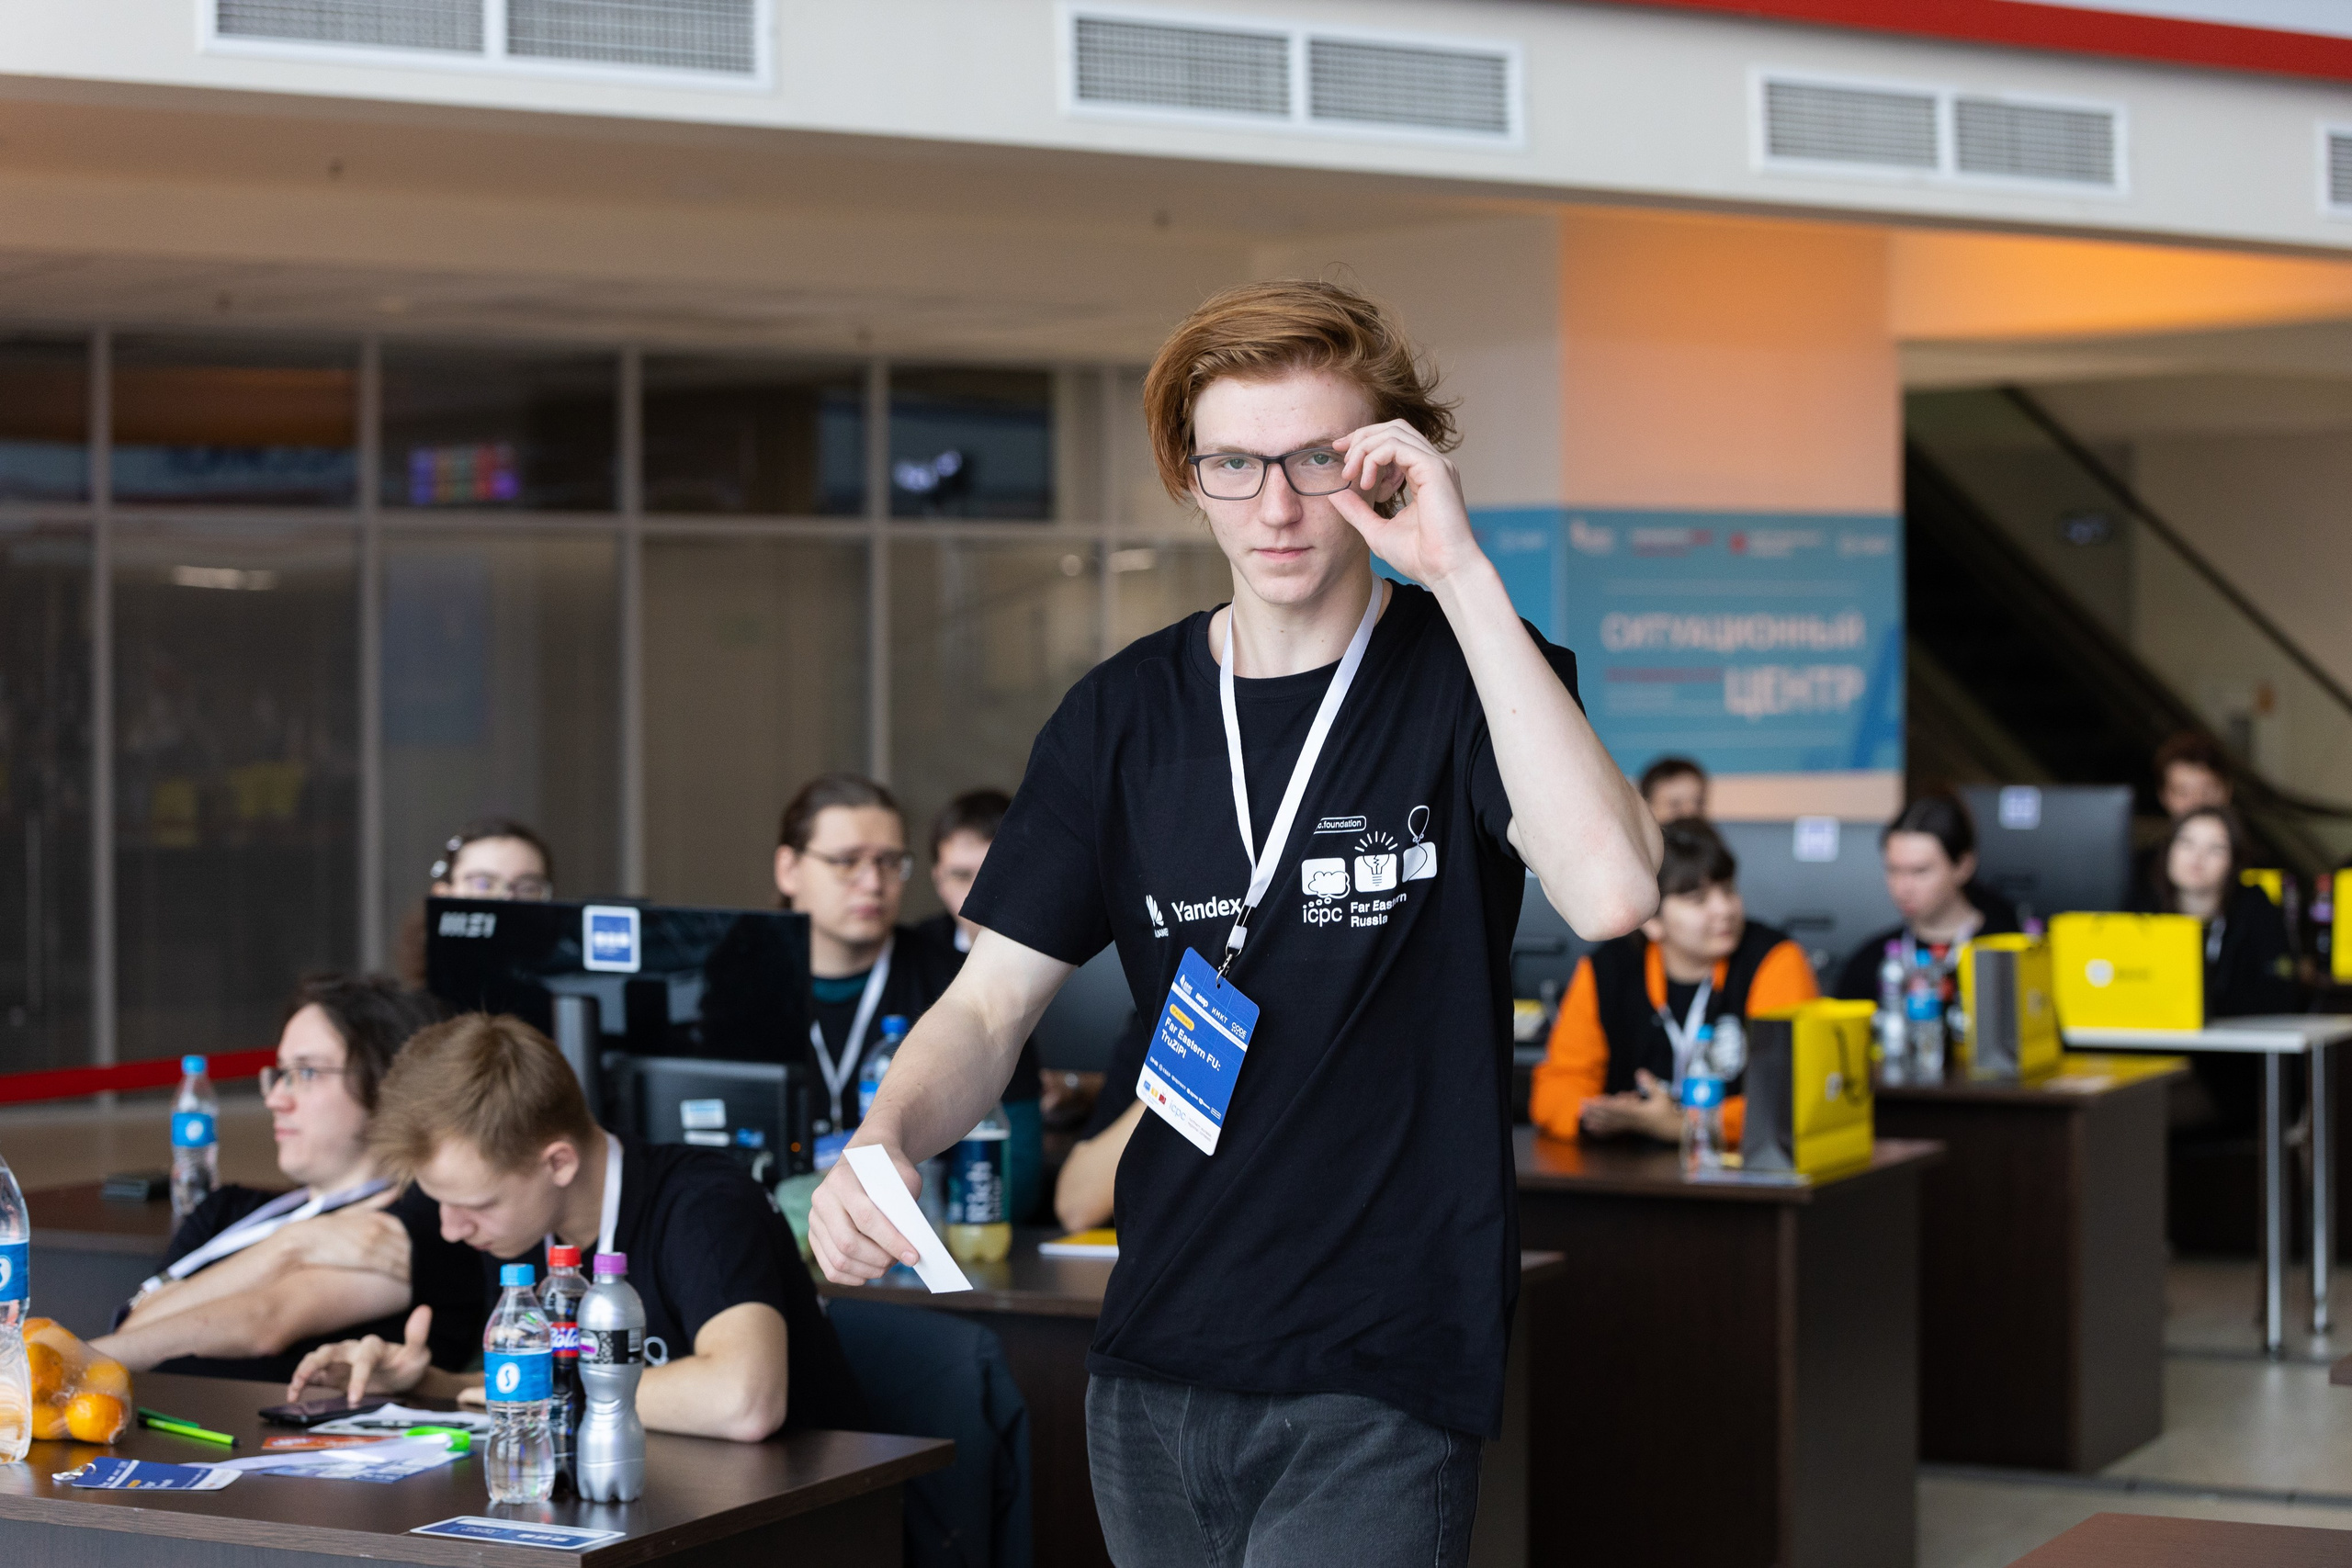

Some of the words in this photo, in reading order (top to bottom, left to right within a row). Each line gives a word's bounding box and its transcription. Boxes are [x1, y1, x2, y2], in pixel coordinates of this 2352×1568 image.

[1171, 897, 1241, 922] Yandex
[1303, 905, 1342, 927] icpc
[1351, 902, 1370, 913] Far
[1351, 914, 1388, 928] Russia
[1231, 1021, 1248, 1038] CODE
[1164, 1016, 1178, 1034] Far
[1177, 1028, 1206, 1059] Eastern
[1206, 1053, 1221, 1072] FU:
